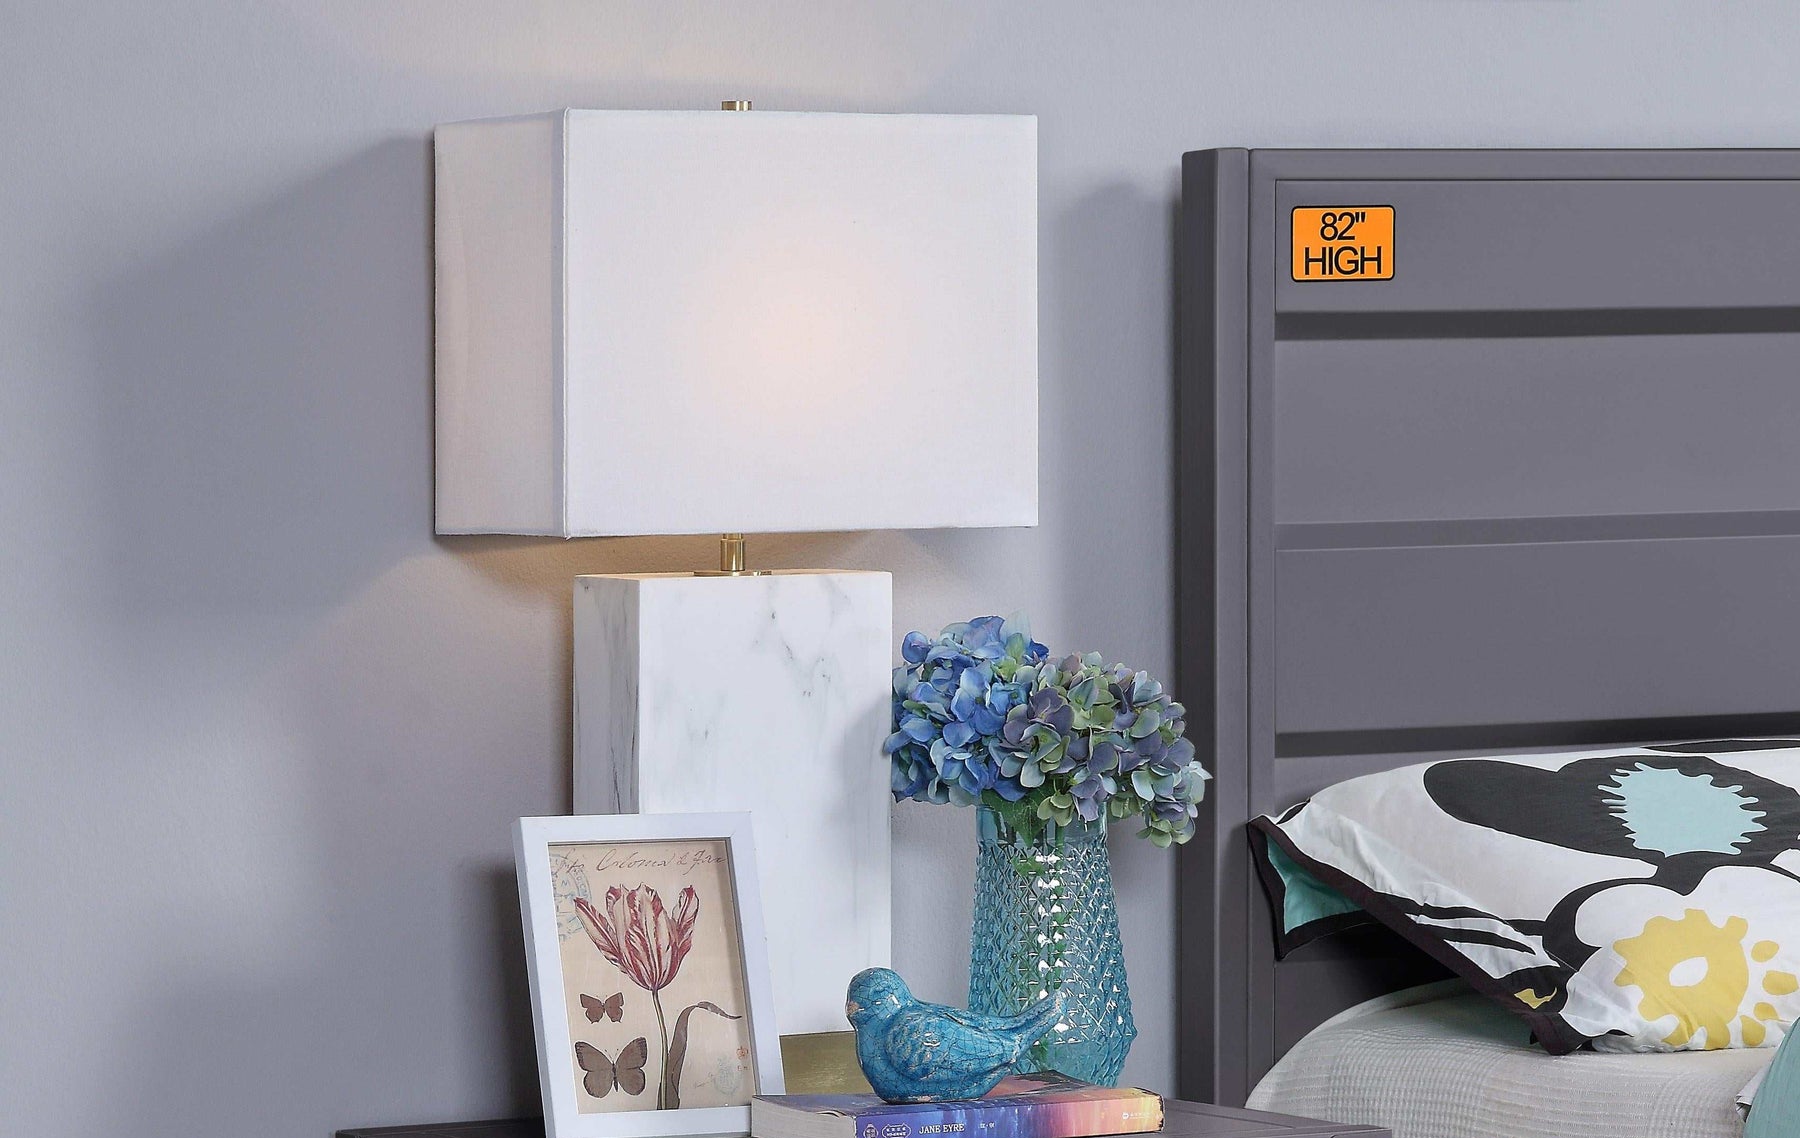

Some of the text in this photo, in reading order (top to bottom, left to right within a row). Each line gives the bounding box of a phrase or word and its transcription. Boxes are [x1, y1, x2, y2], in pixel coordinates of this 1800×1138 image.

[1319, 211, 1366, 241] 82"
[1304, 245, 1382, 275] HIGH
[918, 1125, 941, 1134] JANE
[943, 1123, 965, 1133] EYRE
